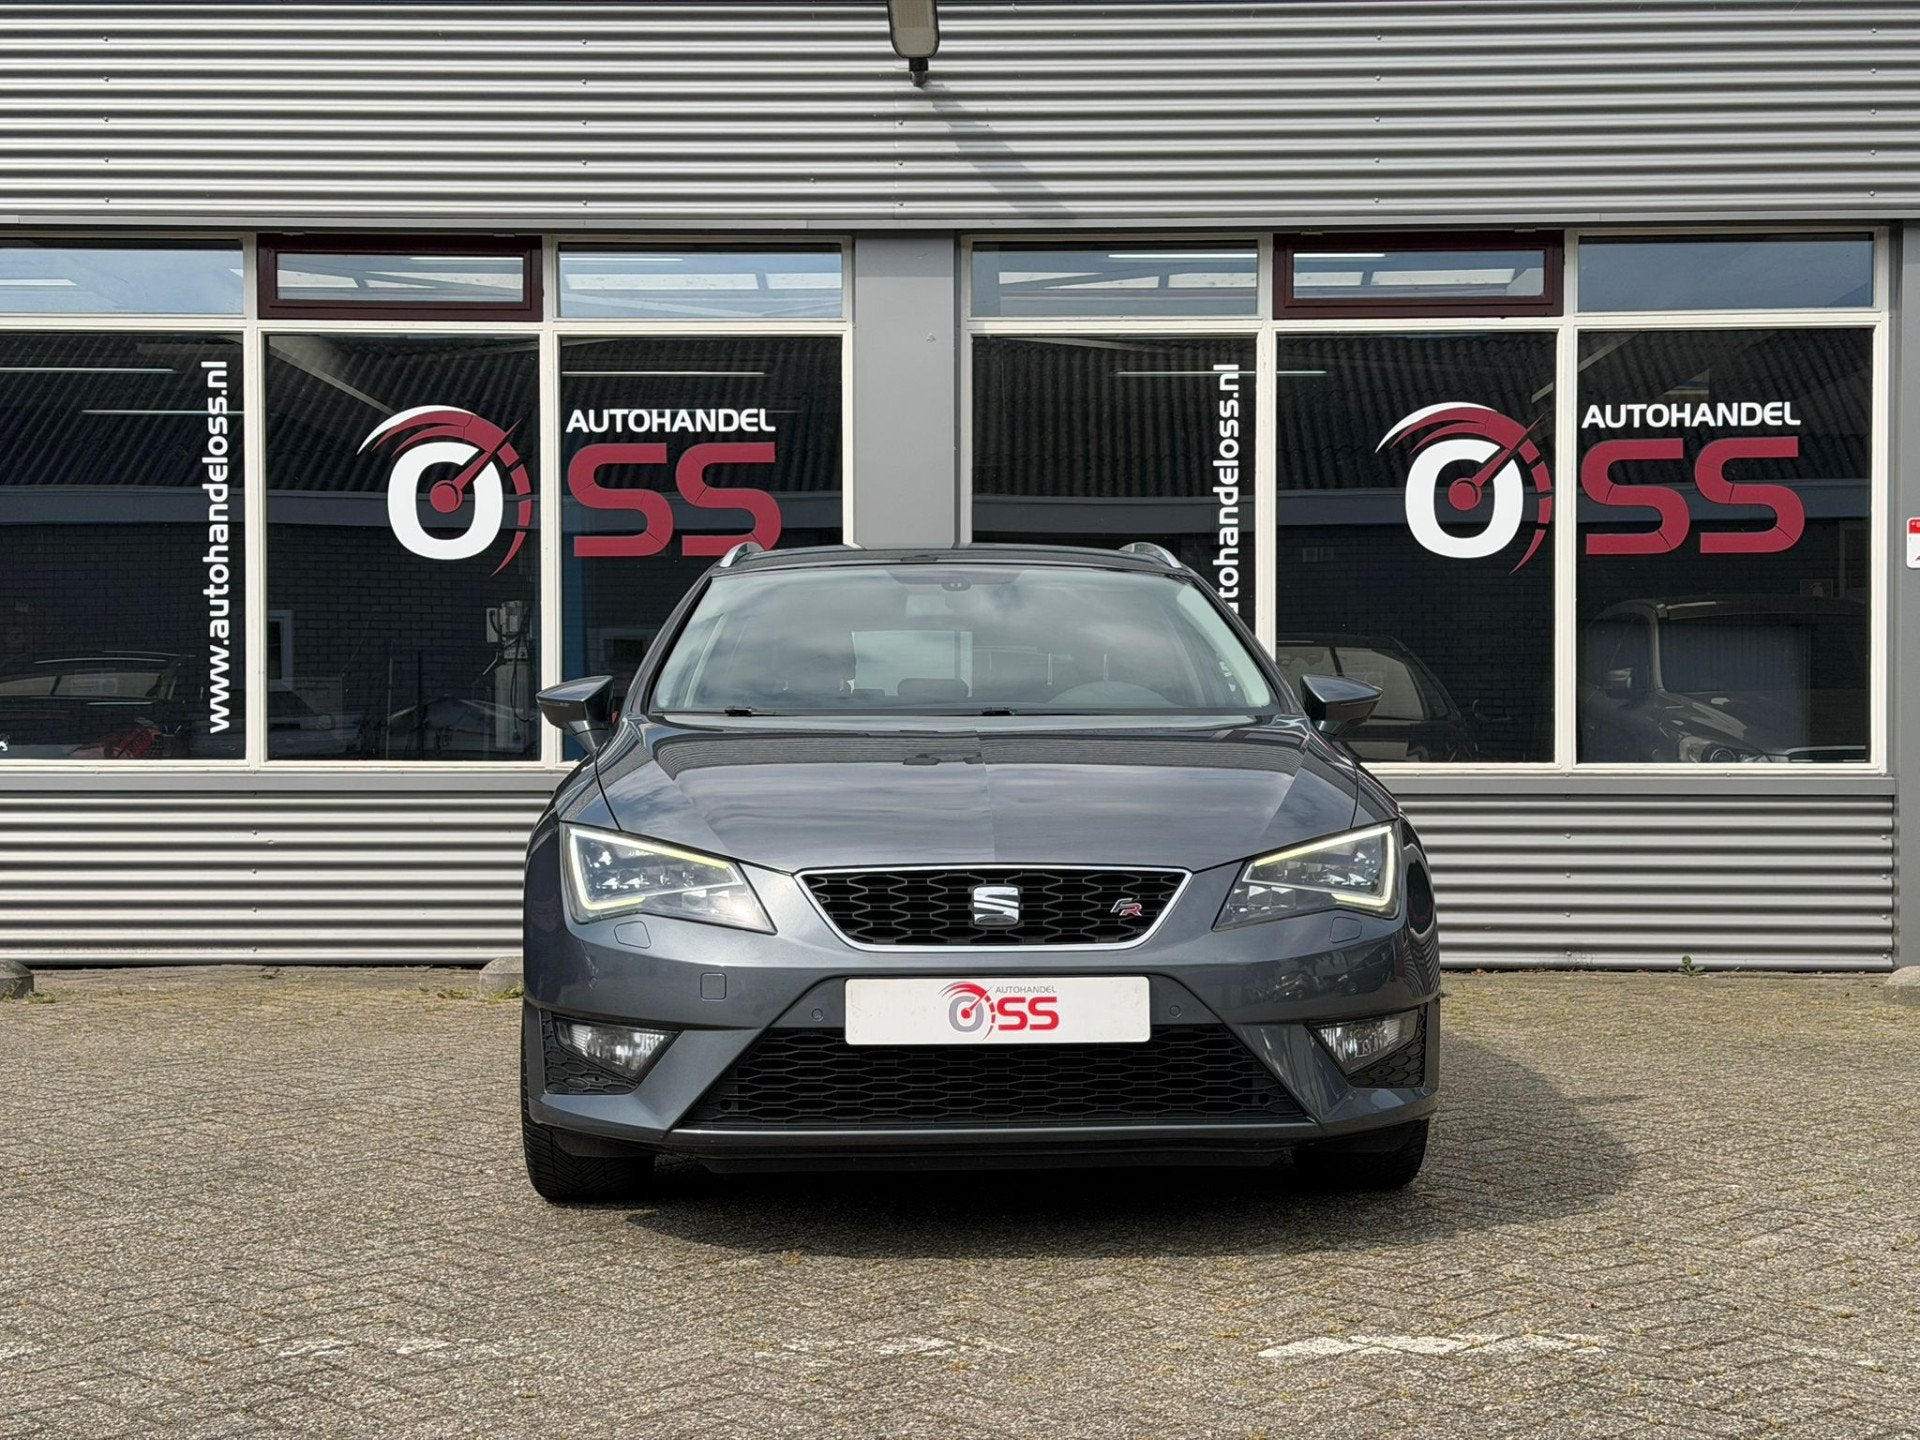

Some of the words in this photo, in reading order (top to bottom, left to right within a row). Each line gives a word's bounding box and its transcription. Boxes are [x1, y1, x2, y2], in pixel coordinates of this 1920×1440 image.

[565, 407, 776, 434] AUTOHANDEL
[1581, 401, 1802, 429] AUTOHANDEL
[202, 361, 230, 734] www.autohandeloss.nl
[995, 985, 1057, 994] AUTOHANDEL
[948, 995, 1060, 1033] OSS
